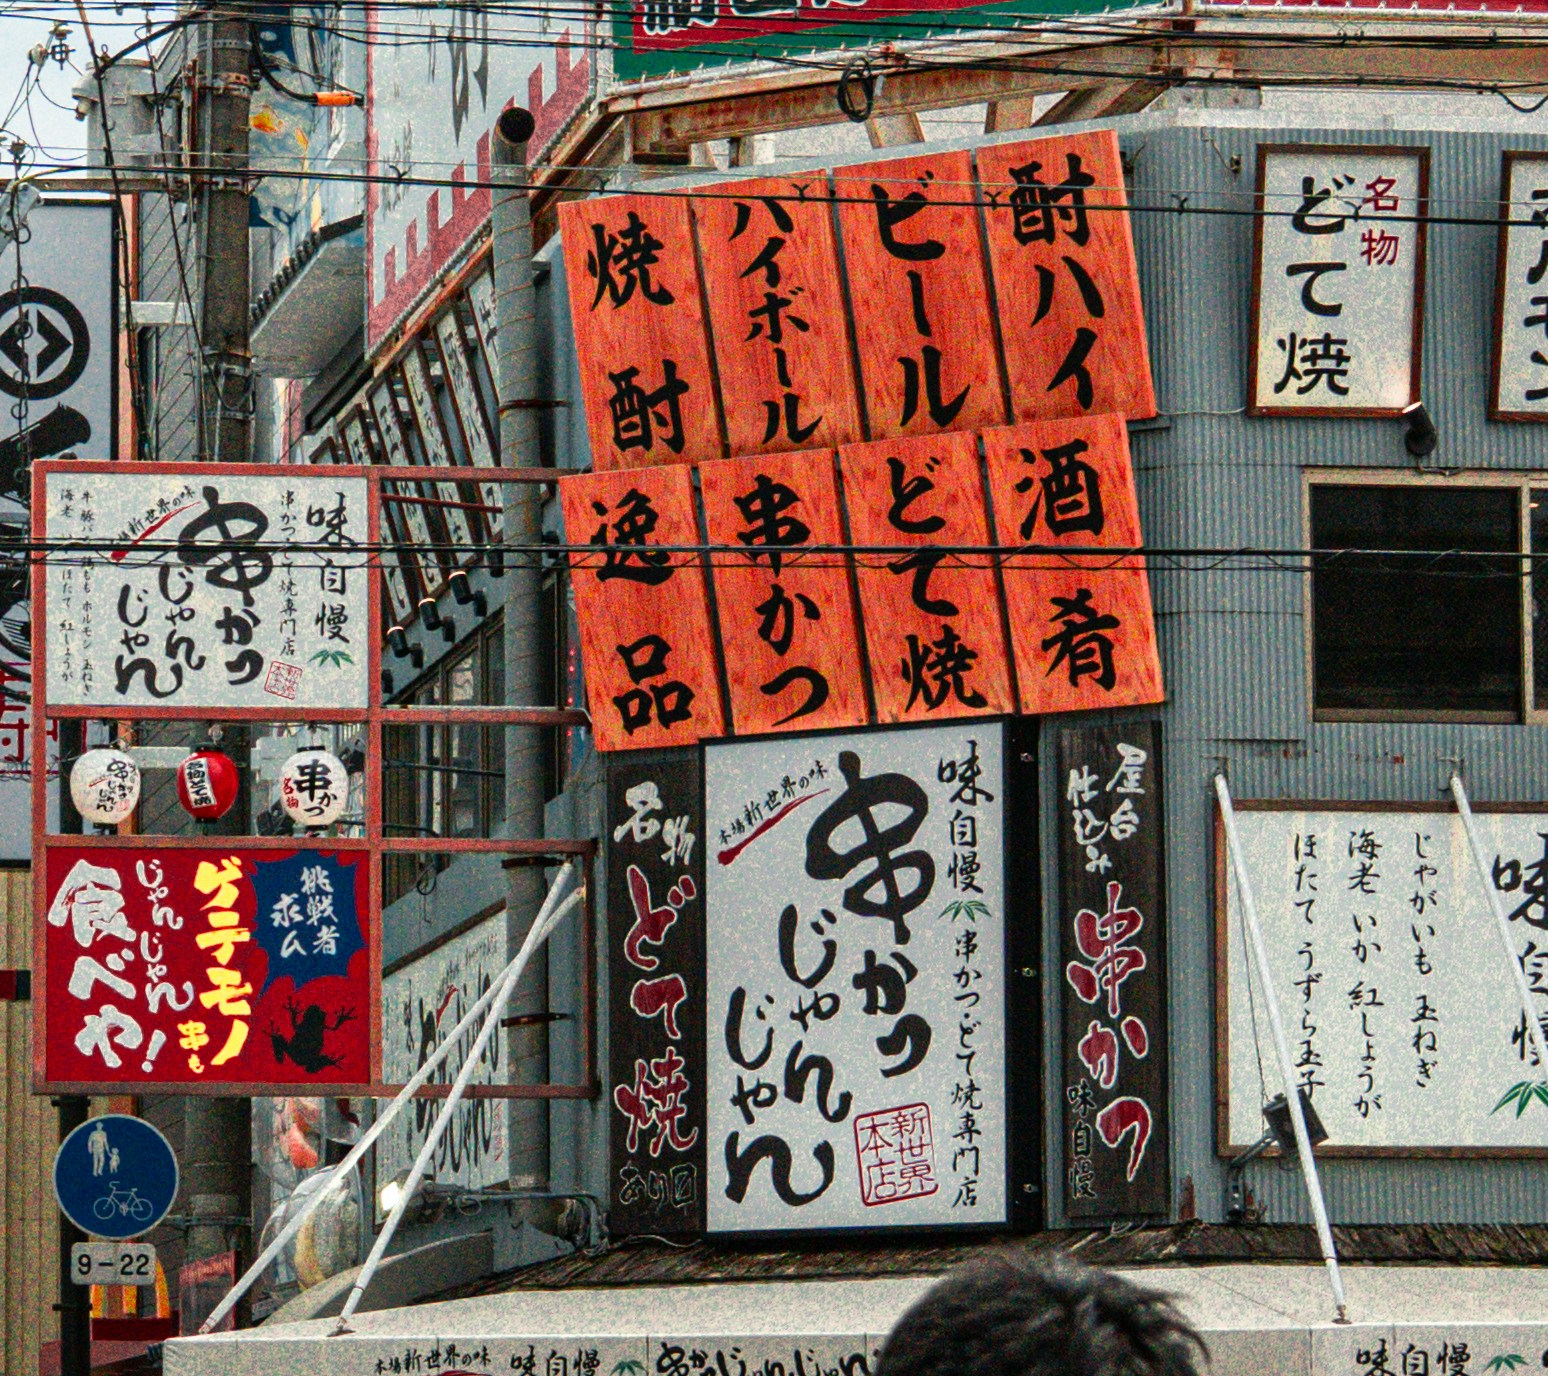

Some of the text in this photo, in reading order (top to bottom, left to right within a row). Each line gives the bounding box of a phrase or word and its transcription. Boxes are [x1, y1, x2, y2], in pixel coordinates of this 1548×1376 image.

[728, 194, 824, 447] ハイボール
[872, 169, 972, 428] ビール
[1007, 152, 1105, 410] 酎ハイ
[1273, 174, 1356, 399] どて焼
[1360, 174, 1401, 268] 名物
[587, 212, 691, 455] 焼酎
[115, 584, 183, 699] じゃん
[158, 563, 207, 671] じゃん
[177, 486, 273, 685] 串かつ
[307, 492, 355, 644] 味自慢
[590, 486, 696, 736] 逸品
[732, 472, 830, 728] 串かつ
[884, 454, 990, 716] どて焼
[1016, 439, 1122, 691] 酒肴
[295, 759, 338, 818] 串かつ
[613, 781, 697, 867] 名物
[718, 759, 830, 844] 本場新世界の味
[938, 740, 994, 894] 味自慢
[1066, 766, 1113, 874] 仕込み
[1105, 743, 1148, 842] 屋台
[136, 858, 195, 1013] じゃんじゃん
[194, 855, 252, 1066] ゲテモノ
[270, 893, 308, 958] 求ム
[300, 866, 341, 956] 挑戦者
[614, 864, 698, 1158] どて焼
[778, 904, 853, 1124] じゃん
[804, 750, 937, 1079] 串かつ
[1293, 833, 1325, 1100] ほたて うずら玉子
[1348, 831, 1384, 1118] 海老 いか 紅しょうが
[1410, 832, 1439, 1088] じゃがいも 玉ねぎ
[177, 1021, 211, 1074] 串も
[724, 985, 835, 1207] じゃん
[950, 929, 983, 1209] 串かつ・どて焼専門店
[1066, 880, 1153, 1184] 串かつ
[860, 1116, 899, 1202] 本店
[892, 1106, 937, 1196] 新世界
[1067, 1082, 1097, 1200] 味自慢
